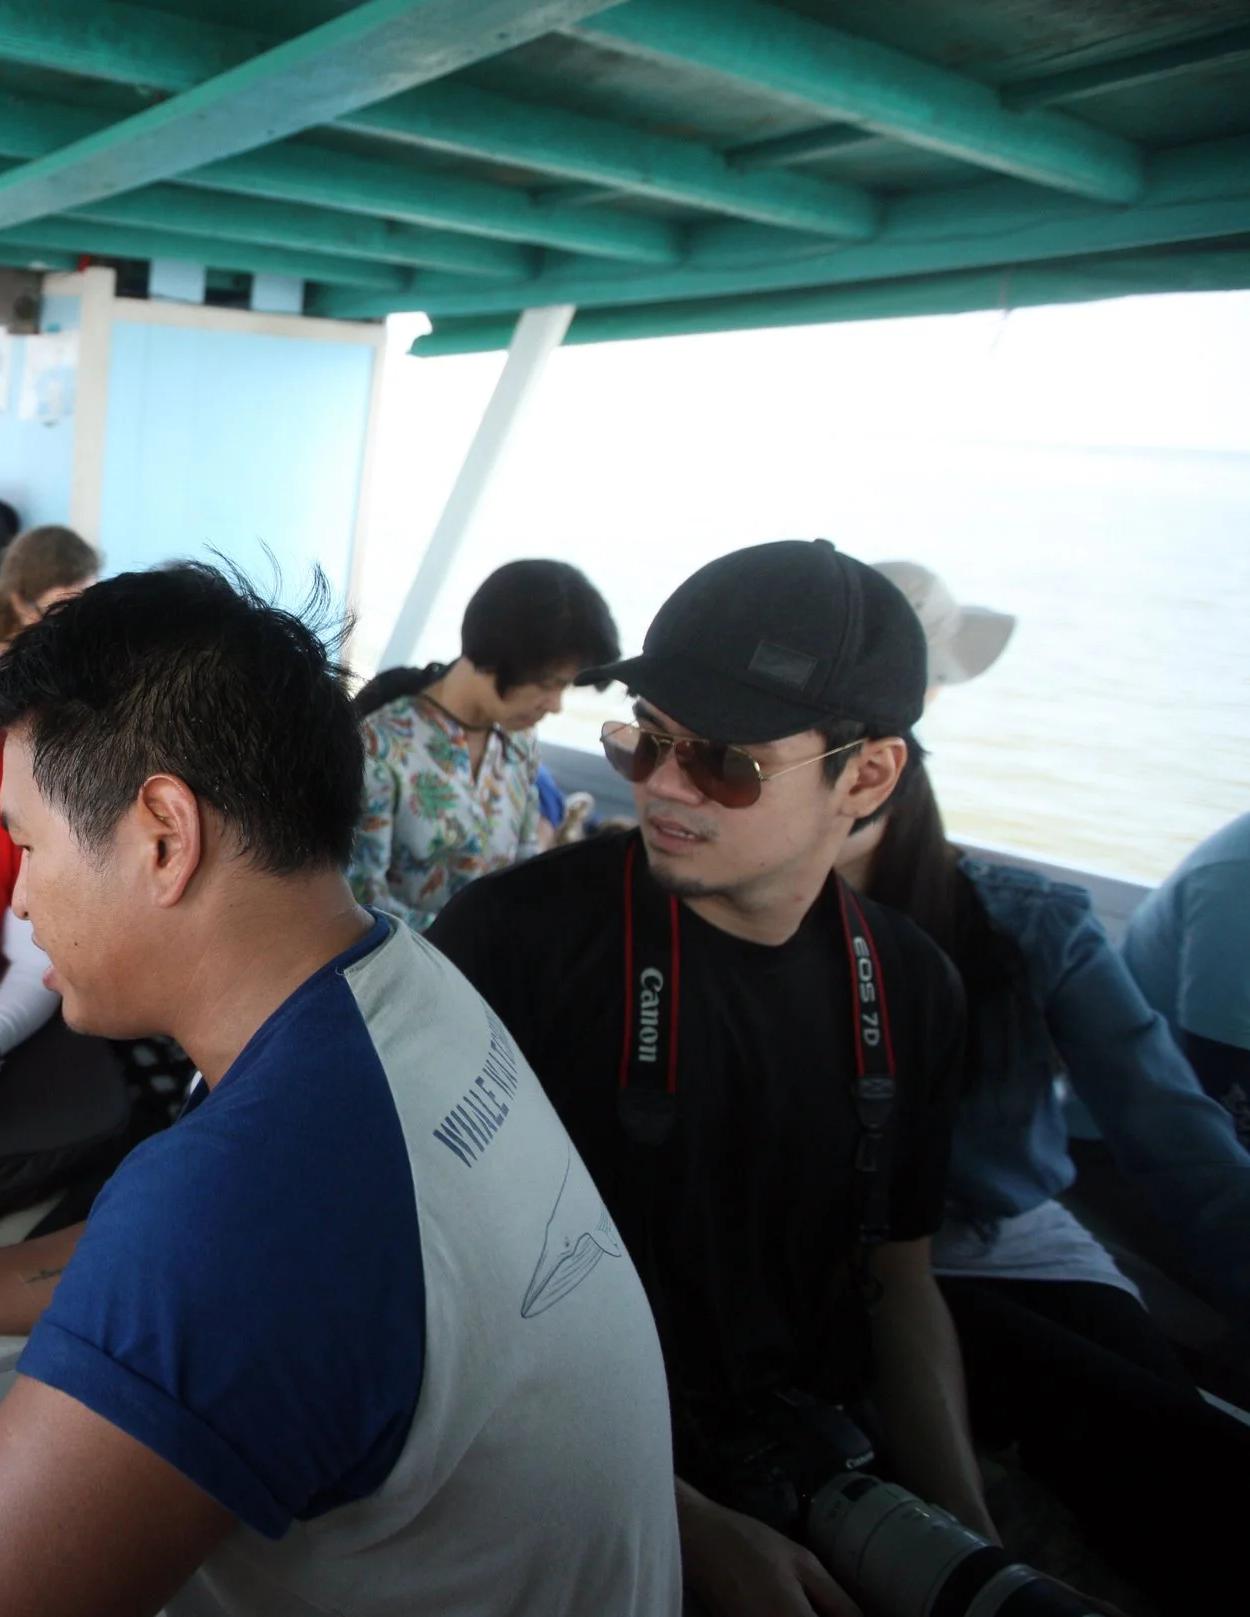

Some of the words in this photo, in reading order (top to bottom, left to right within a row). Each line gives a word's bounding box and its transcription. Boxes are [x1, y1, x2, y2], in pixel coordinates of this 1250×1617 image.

[853, 936, 876, 1003] EOS
[638, 967, 664, 1063] Canon
[862, 1012, 881, 1046] 7D
[432, 1076, 510, 1169] WHALE
